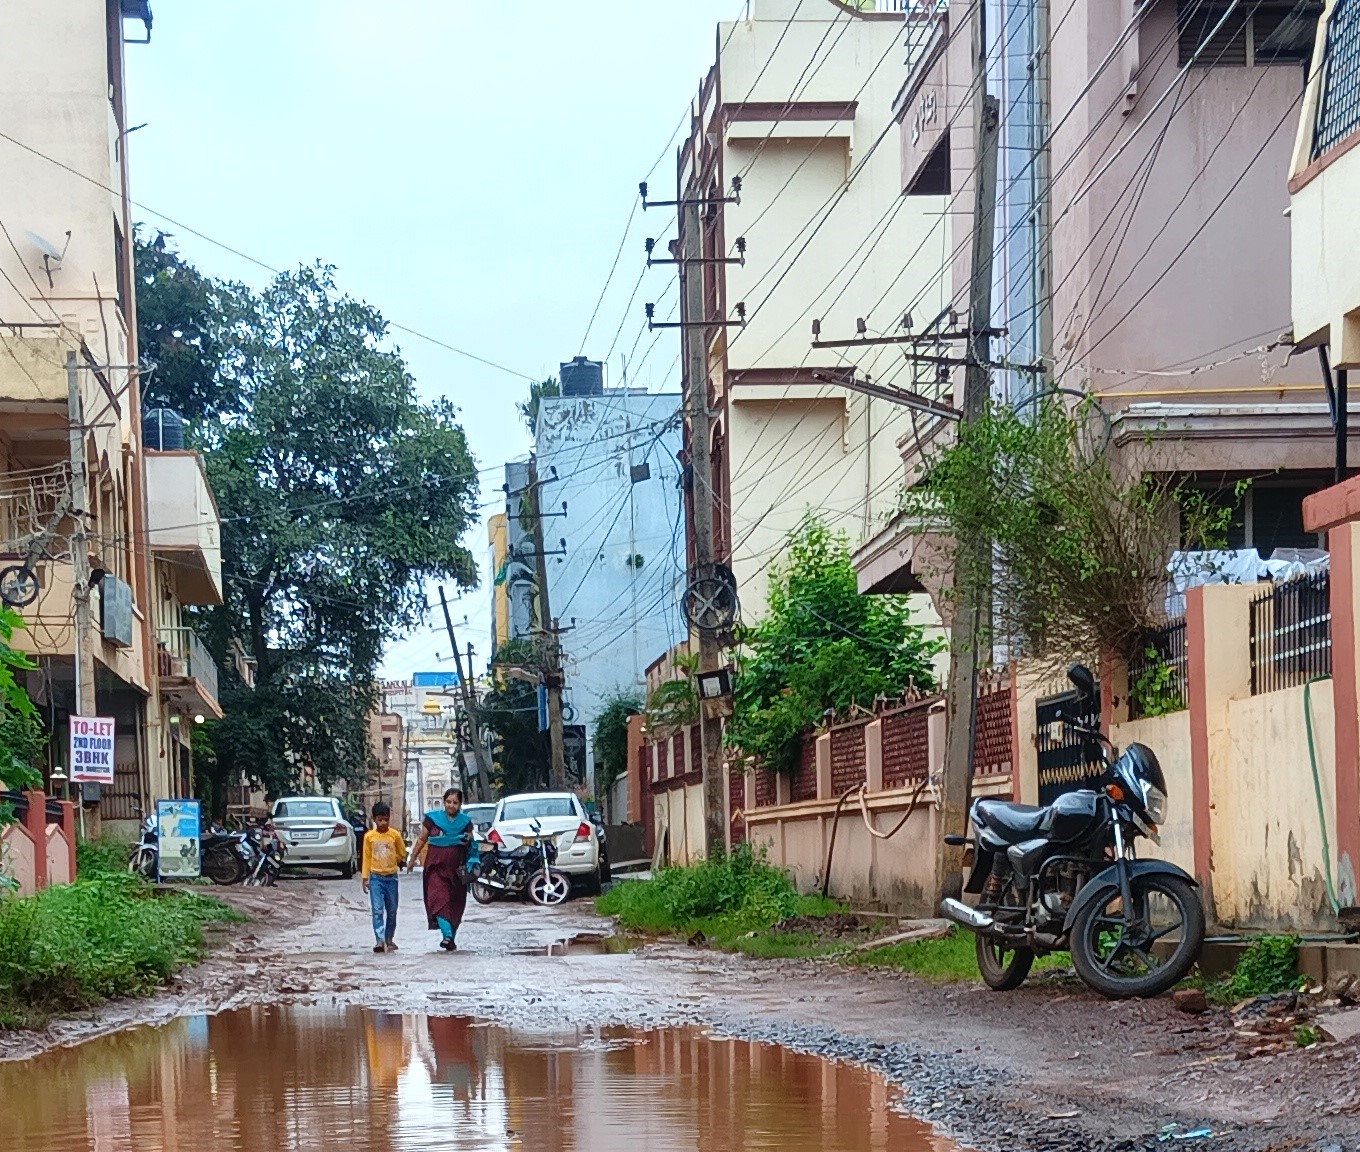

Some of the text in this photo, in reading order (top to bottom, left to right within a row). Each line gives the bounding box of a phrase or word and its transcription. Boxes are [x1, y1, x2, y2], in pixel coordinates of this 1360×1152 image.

[73, 720, 113, 736] TO-LET
[90, 737, 111, 750] FLOOR
[75, 750, 109, 765] 3BHK
